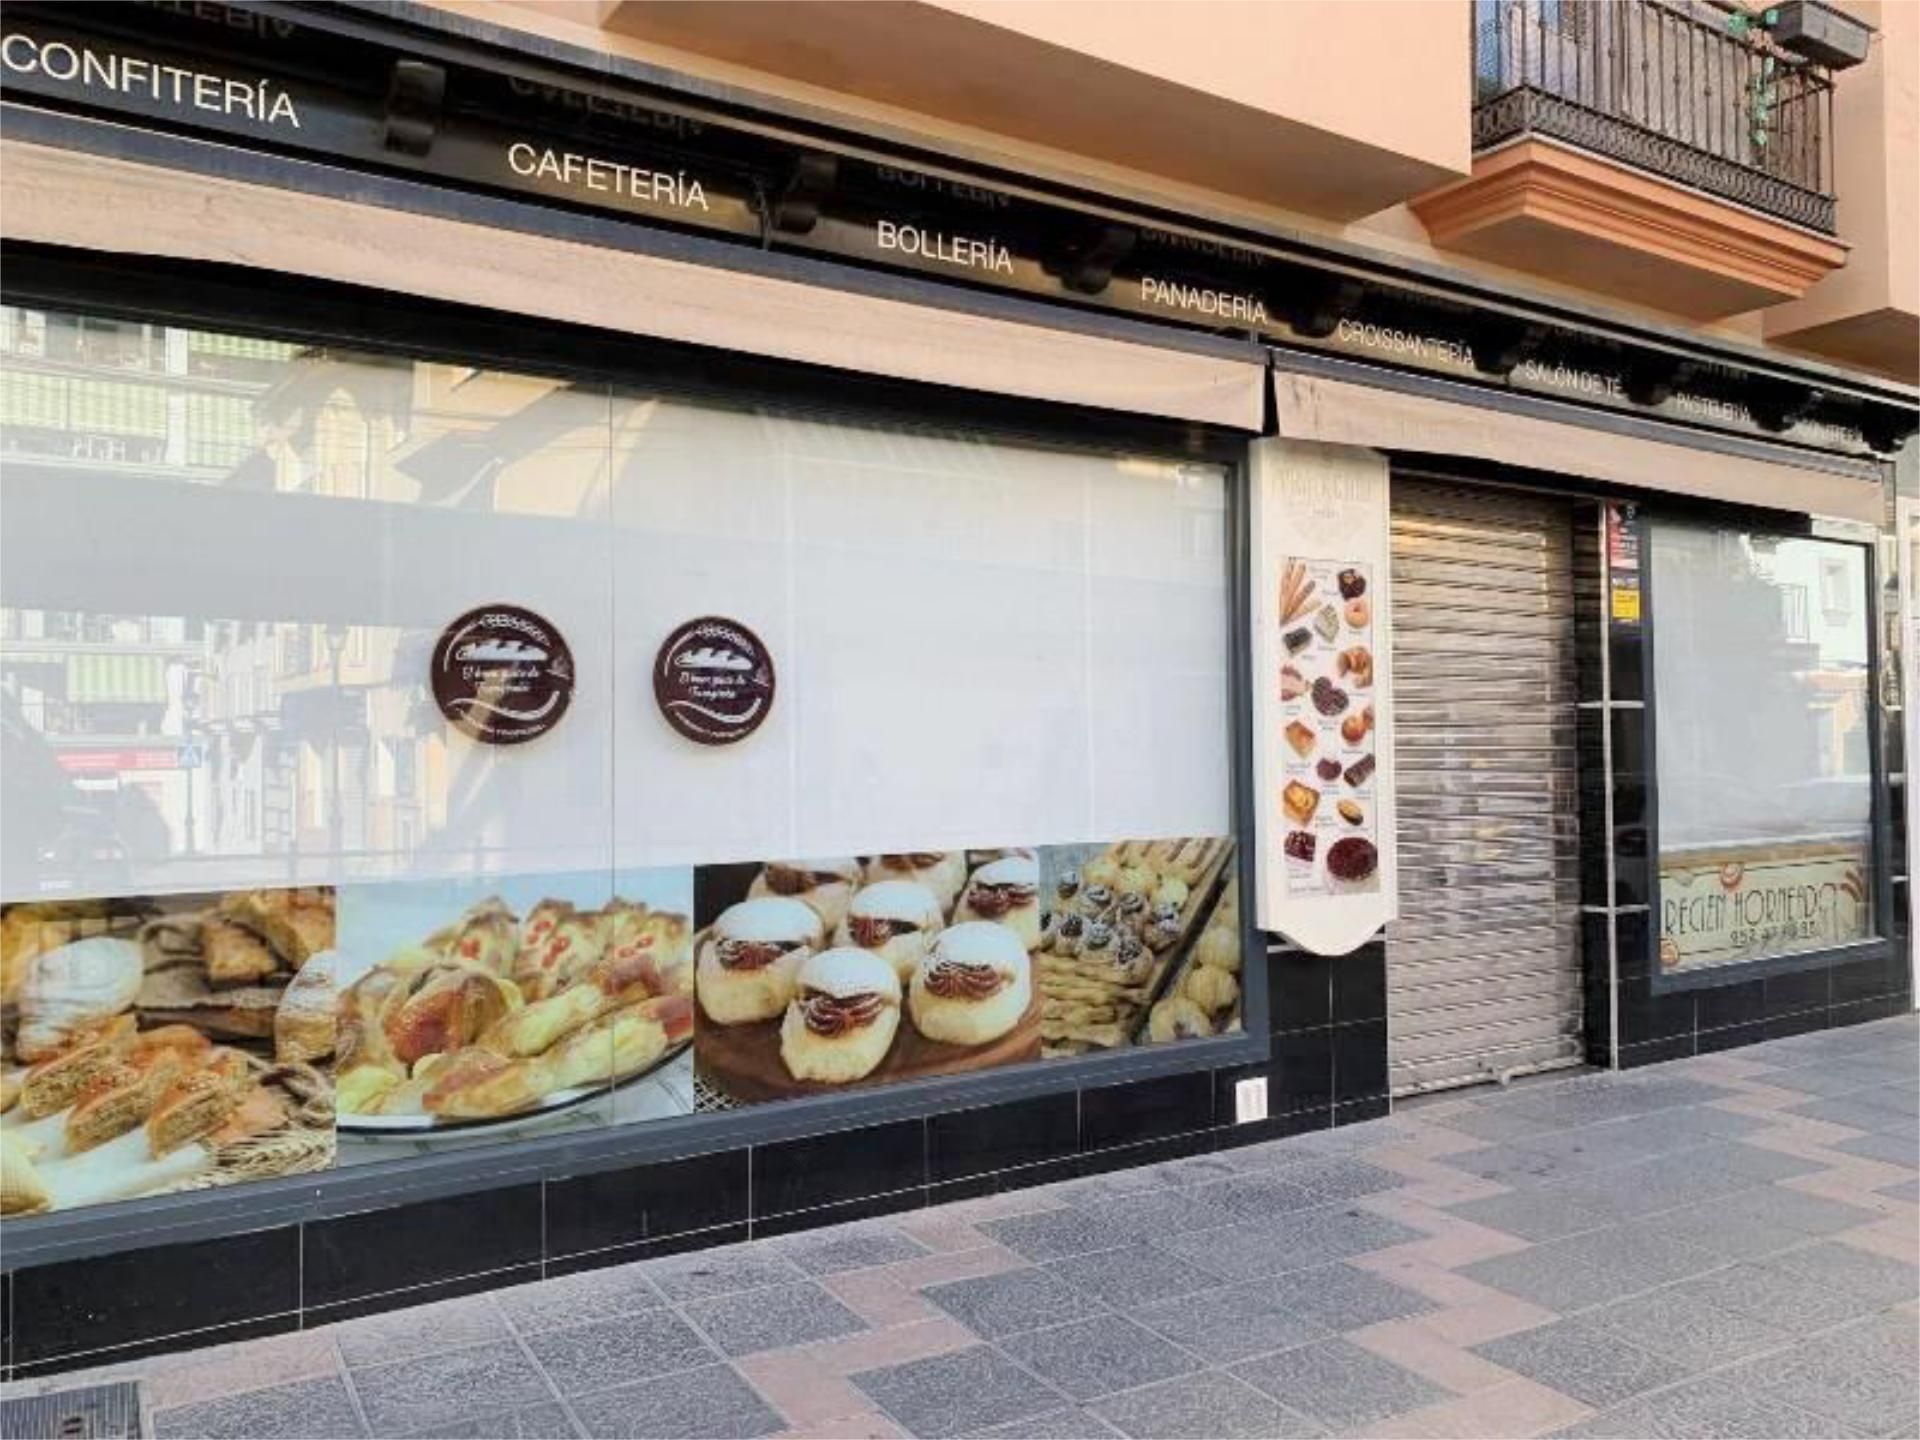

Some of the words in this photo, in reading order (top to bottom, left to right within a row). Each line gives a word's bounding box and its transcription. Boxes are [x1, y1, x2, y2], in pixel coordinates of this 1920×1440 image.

[2, 33, 300, 129] CONFITERÍA
[508, 142, 711, 212] CAFETERÍA
[877, 219, 1014, 275] BOLLERÍA
[1141, 276, 1268, 325] PANADERÍA
[1336, 318, 1475, 368] CROISSANTERÍA
[1525, 359, 1578, 390] SALÓN
[1581, 371, 1603, 395] DE
